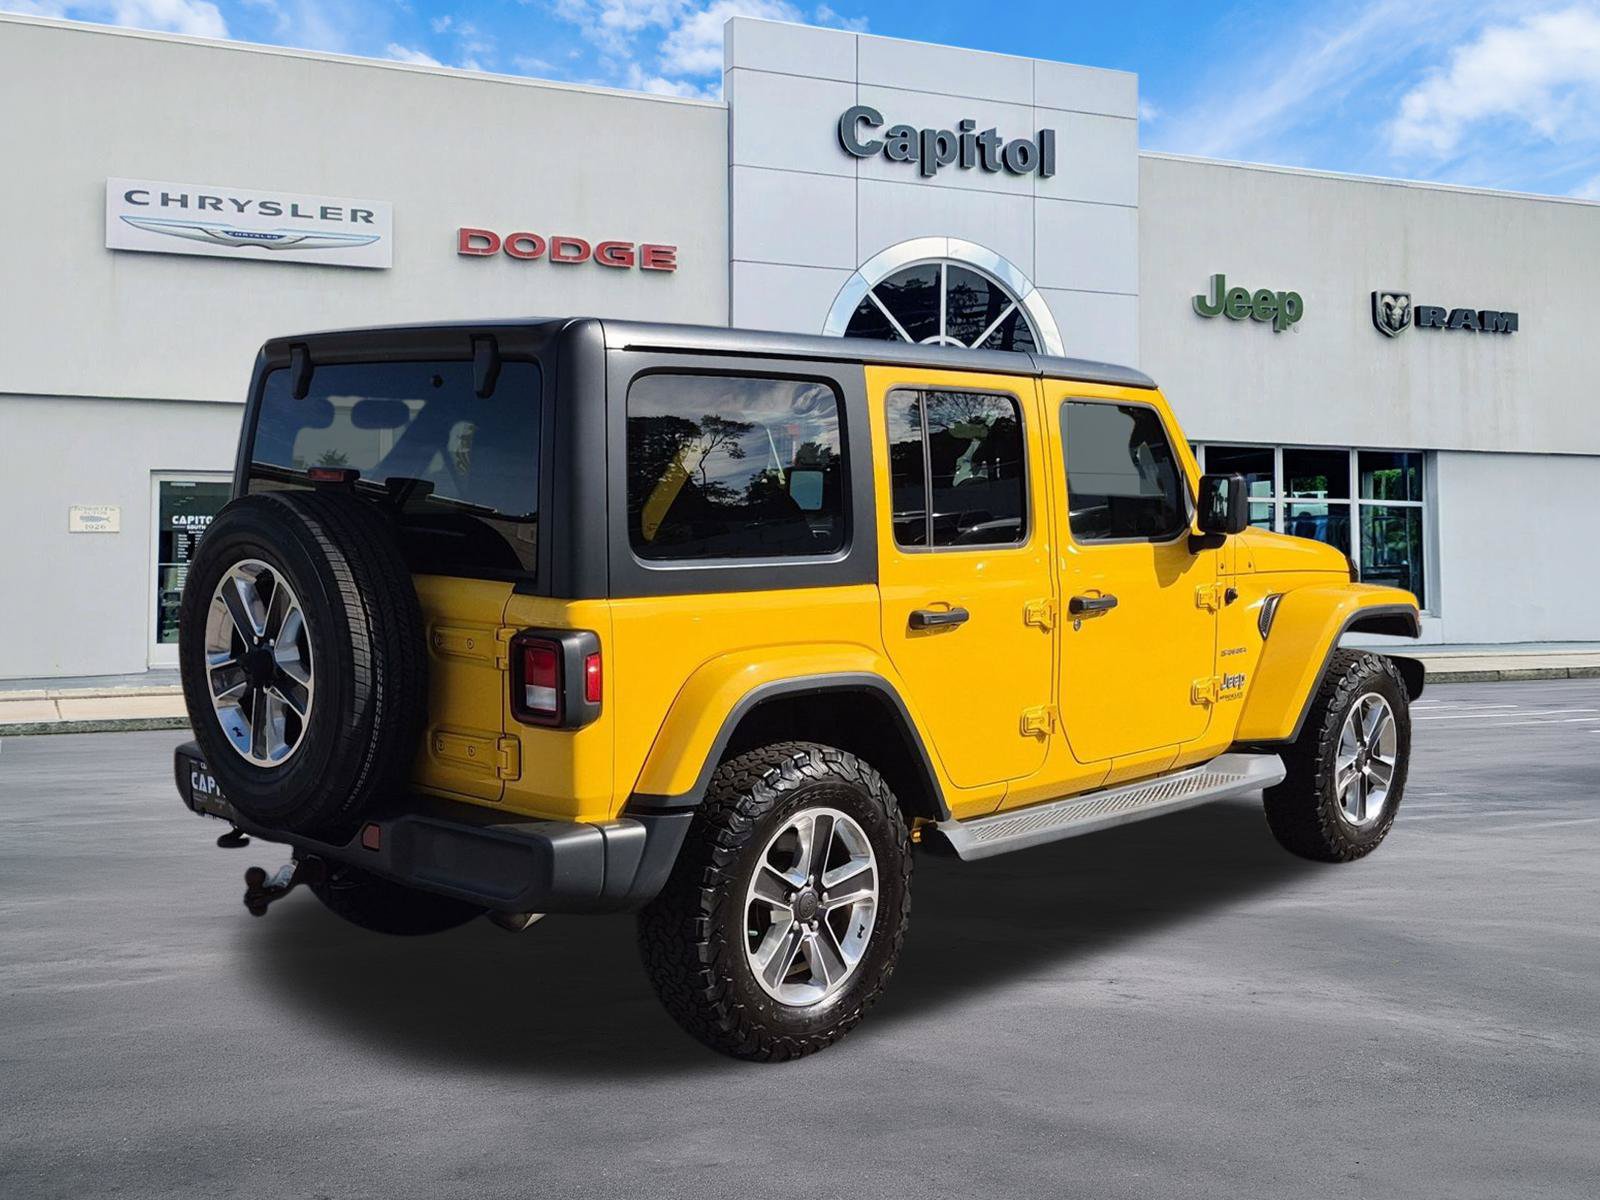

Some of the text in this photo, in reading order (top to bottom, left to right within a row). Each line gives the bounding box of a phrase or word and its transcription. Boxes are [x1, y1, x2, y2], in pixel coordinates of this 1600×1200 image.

[838, 105, 1056, 177] Capitol
[124, 190, 375, 224] CHRYSLER
[457, 227, 678, 272] DODGE
[1192, 274, 1304, 332] Jeep
[1414, 305, 1519, 334] RAM
[171, 515, 214, 525] CAPITO
[191, 772, 225, 798] CAPI
